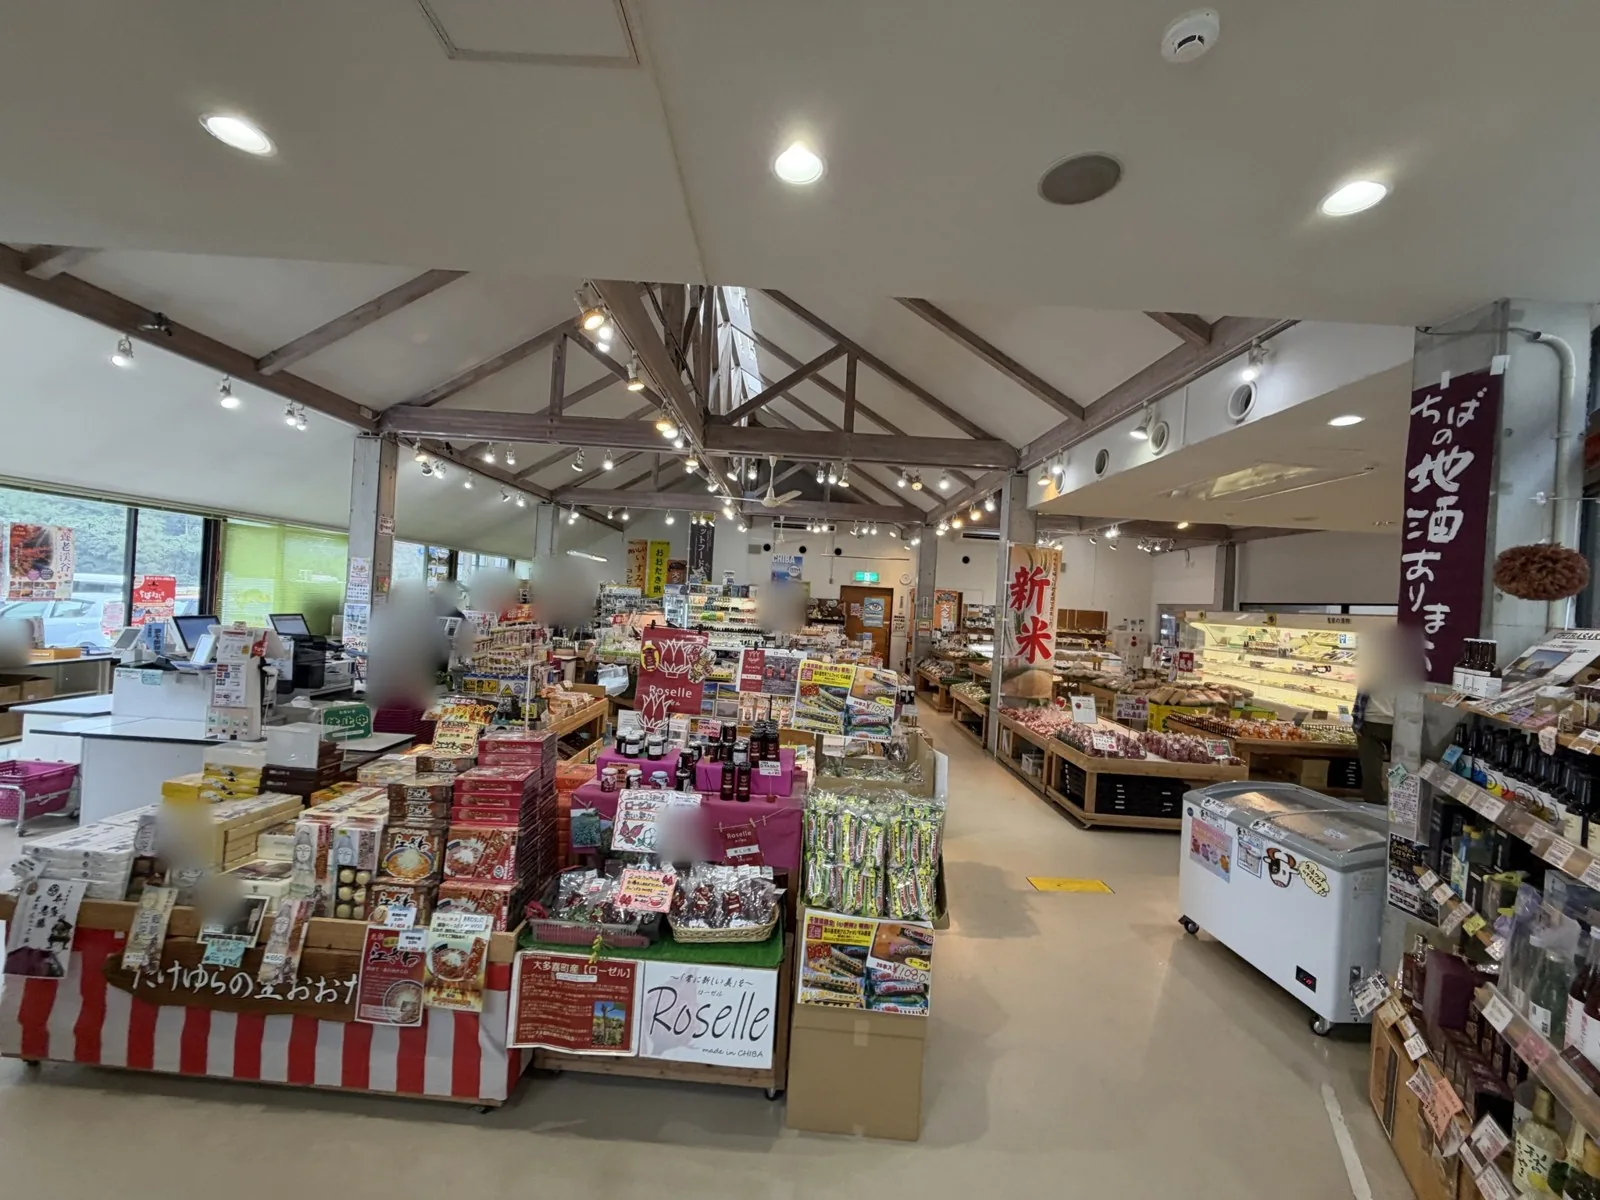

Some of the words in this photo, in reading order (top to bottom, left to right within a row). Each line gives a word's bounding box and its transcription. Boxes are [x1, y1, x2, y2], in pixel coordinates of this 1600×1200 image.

[1402, 386, 1489, 671] ちばの地酒ありま
[771, 554, 796, 565] CHIBA
[1009, 565, 1053, 664] 新米
[649, 684, 693, 699] Roselle
[726, 831, 752, 839] Roselle
[647, 986, 770, 1042] Roselle
[702, 1047, 725, 1055] made
[737, 1050, 764, 1058] CHIBA
